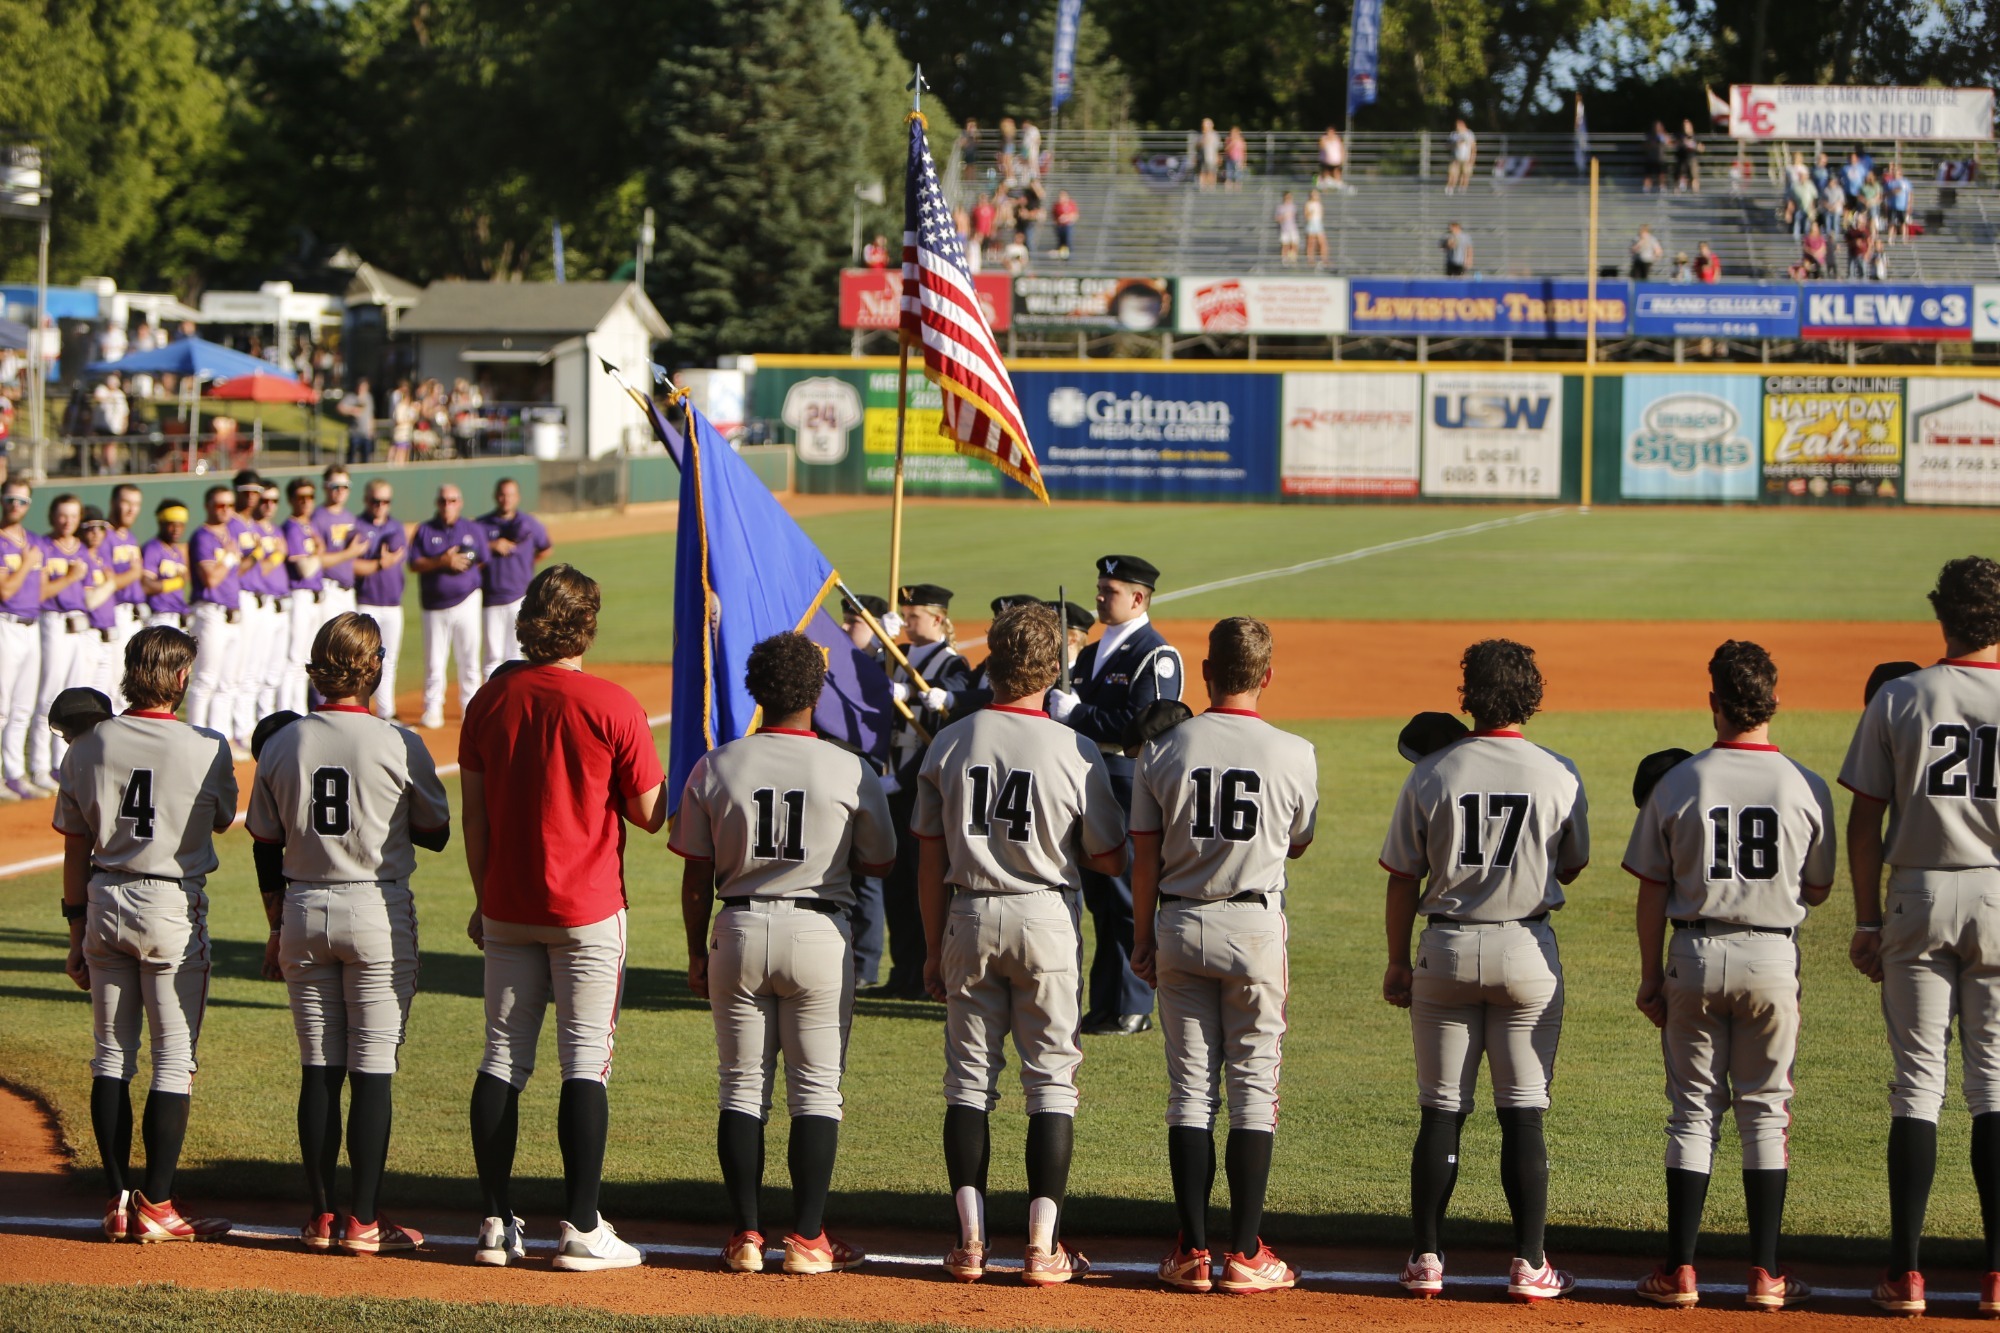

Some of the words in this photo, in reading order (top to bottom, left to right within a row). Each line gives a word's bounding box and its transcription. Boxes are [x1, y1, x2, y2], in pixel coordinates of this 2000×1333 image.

[1796, 110, 1870, 135] HARRIS
[1879, 111, 1932, 136] FIELD
[1809, 294, 1915, 325] KLEW
[1940, 294, 1967, 326] 3
[1764, 376, 1829, 394] ORDER
[1831, 376, 1902, 394] ONLINE
[806, 403, 837, 430] 24
[1086, 390, 1230, 425] Gritman
[1433, 393, 1552, 430] USW
[1089, 423, 1163, 441] MEDICAL
[1164, 423, 1230, 442] CENTER
[1464, 445, 1520, 463] Local
[1504, 466, 1541, 486] 712
[1924, 721, 2000, 801] 21
[119, 767, 157, 842] 4
[311, 765, 352, 838] 8
[966, 764, 1035, 845] 14
[1189, 766, 1262, 844] 16
[750, 787, 808, 864] 11
[1457, 791, 1532, 869] 17
[1706, 804, 1781, 883] 18
